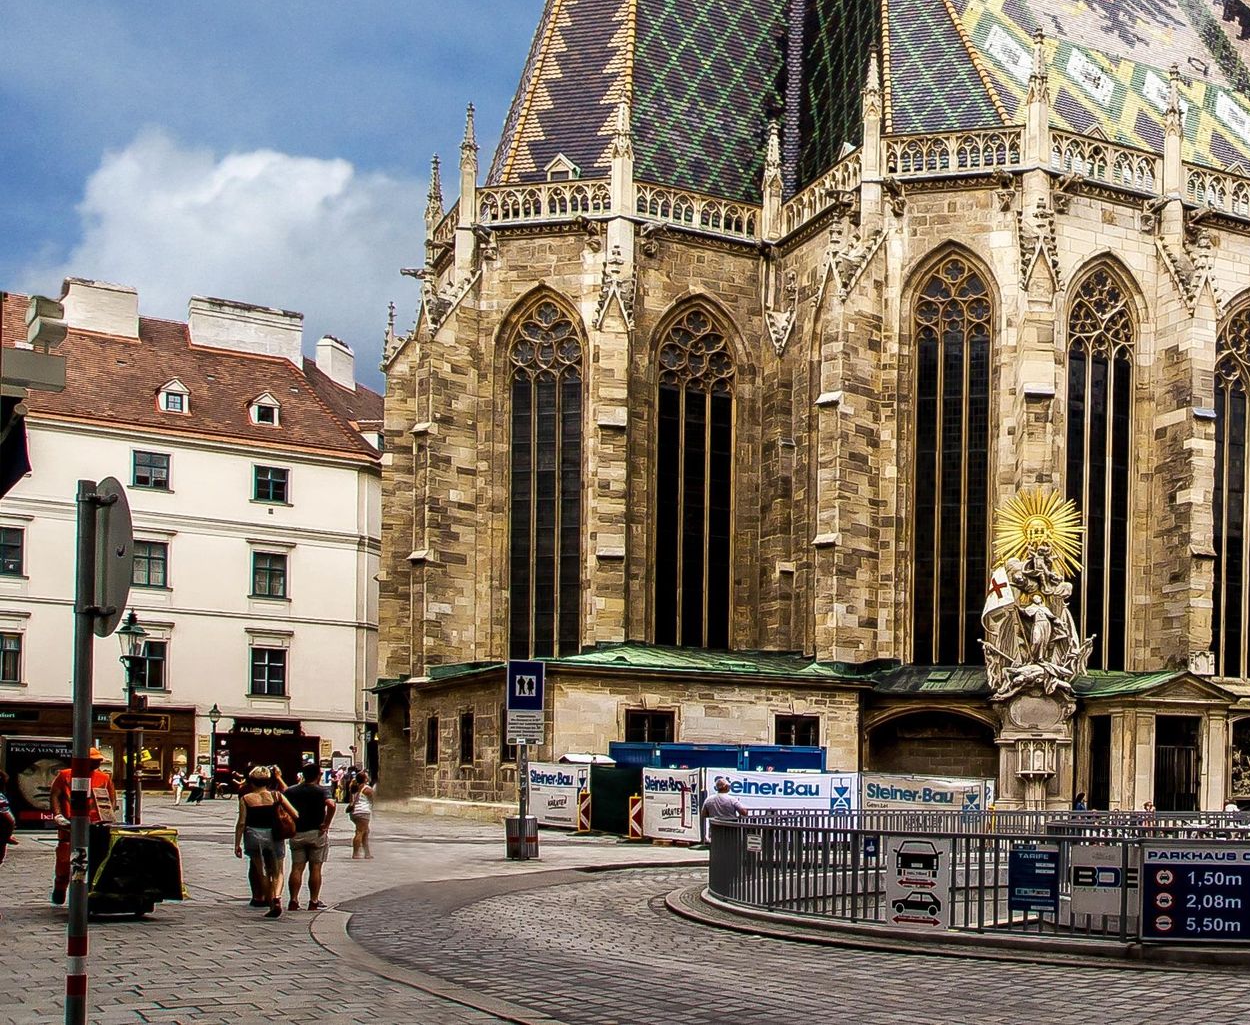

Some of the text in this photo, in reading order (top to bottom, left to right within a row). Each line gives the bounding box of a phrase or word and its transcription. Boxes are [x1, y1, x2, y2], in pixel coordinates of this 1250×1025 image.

[1148, 851, 1237, 861] PARKHAUS
[1187, 871, 1242, 887] 1,50m
[1186, 894, 1242, 910] 2,08m
[1186, 917, 1241, 933] 5,50m
